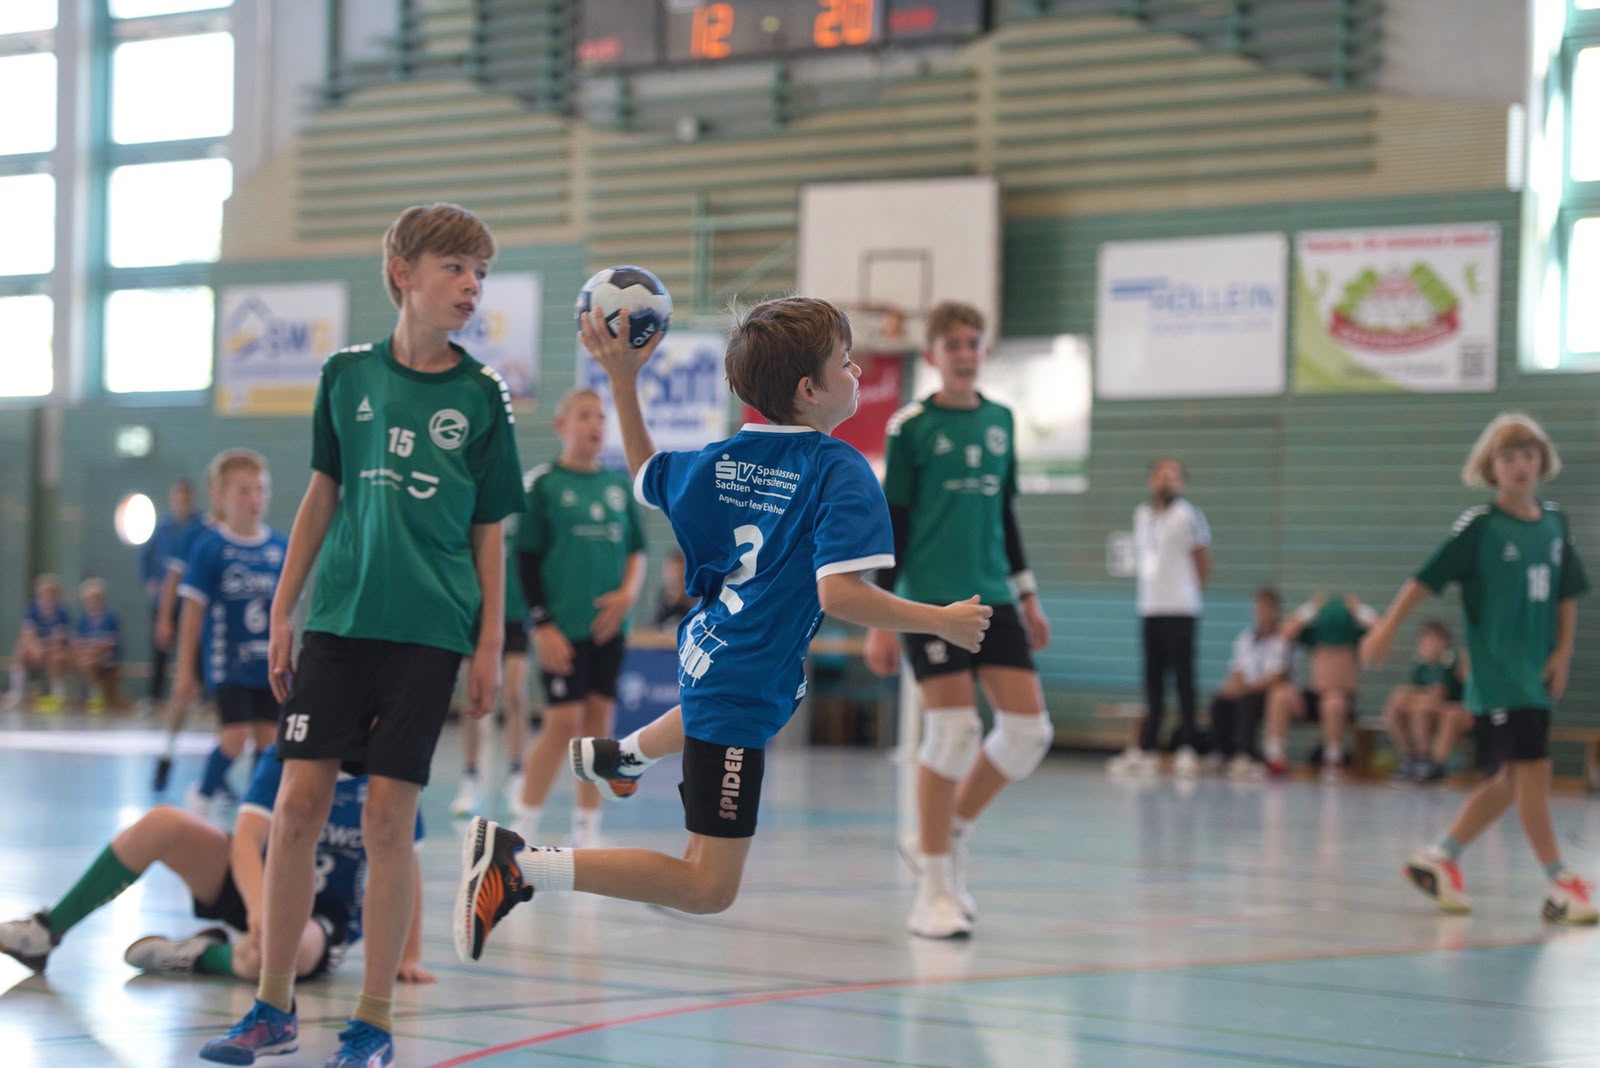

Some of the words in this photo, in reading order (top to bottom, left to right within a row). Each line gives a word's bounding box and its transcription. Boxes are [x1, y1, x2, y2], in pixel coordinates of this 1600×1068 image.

[690, 2, 734, 59] 12
[814, 0, 874, 48] 20
[388, 426, 416, 457] 15
[715, 479, 751, 493] Sachsen
[719, 524, 764, 615] 2
[244, 600, 268, 634] 6
[285, 714, 310, 742] 15
[718, 747, 744, 821] SPIDER
